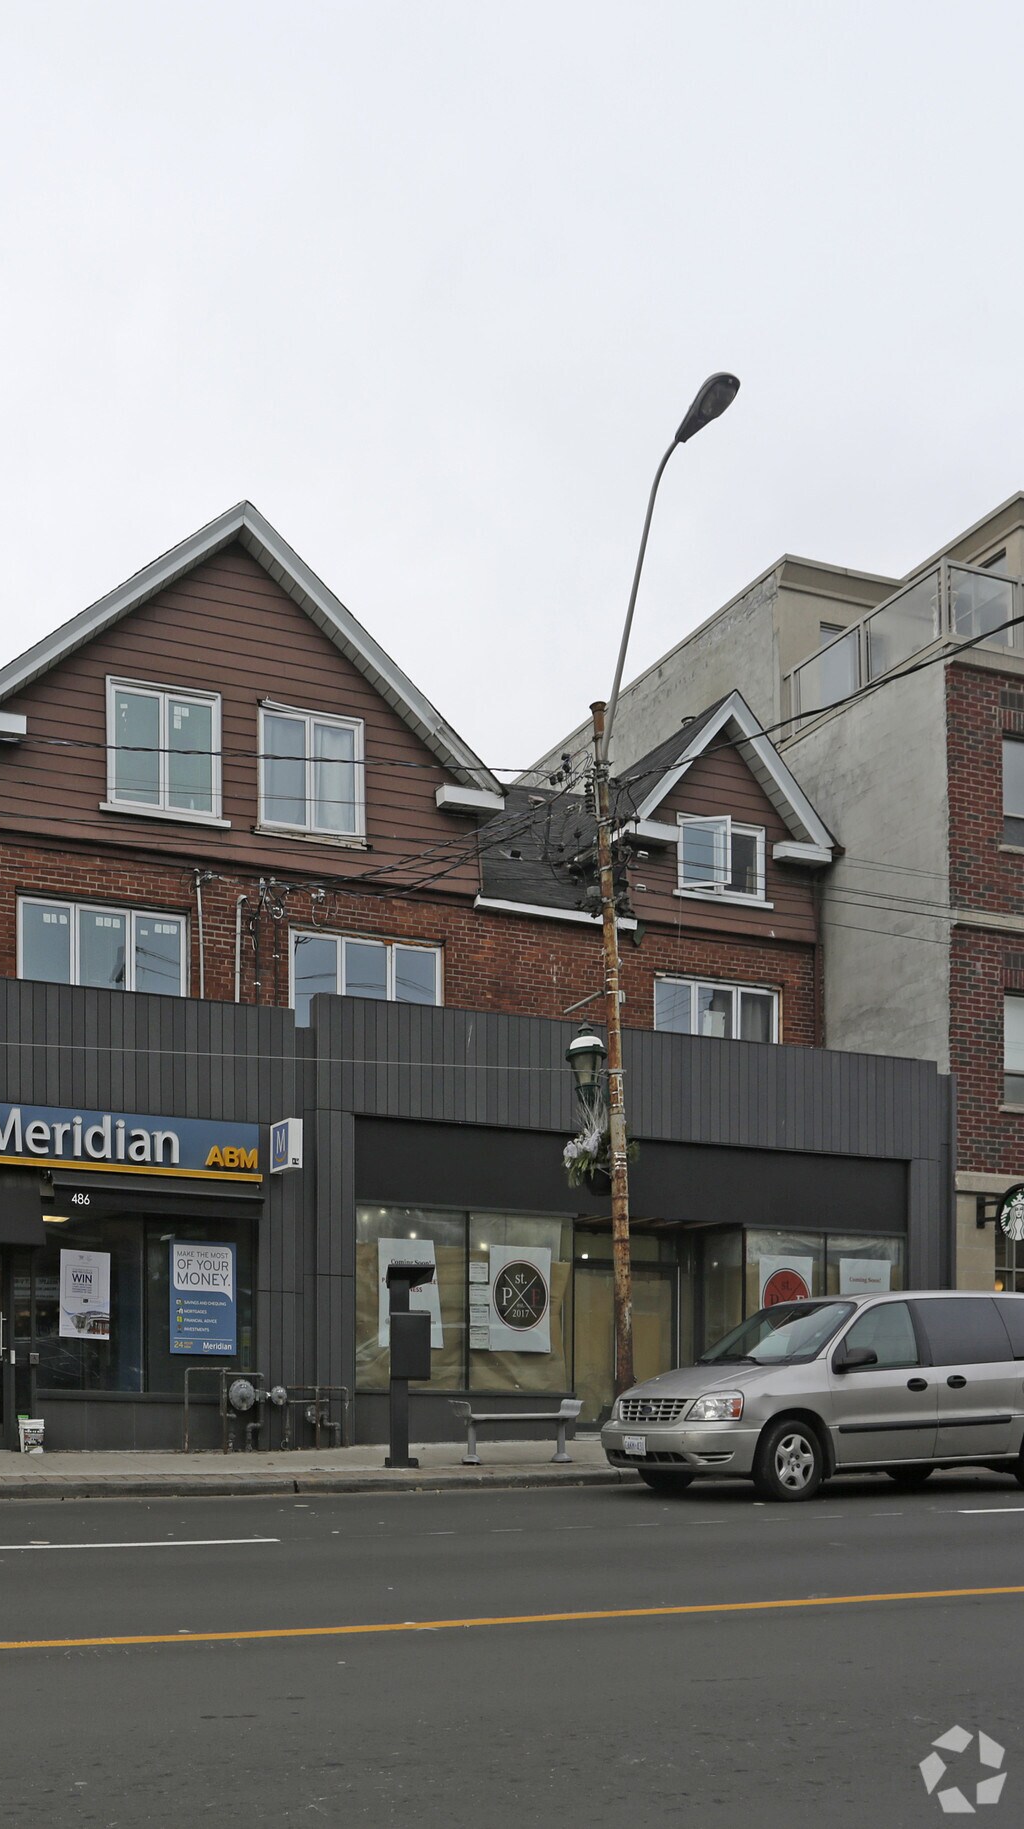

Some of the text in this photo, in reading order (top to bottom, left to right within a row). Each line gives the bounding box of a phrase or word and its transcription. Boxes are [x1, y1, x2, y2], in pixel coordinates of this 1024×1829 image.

[276, 1129, 286, 1154] M
[205, 1144, 259, 1169] ABM
[71, 1193, 91, 1205] 486
[197, 1251, 209, 1259] THE
[177, 1258, 229, 1271] OF YOUR
[71, 1273, 93, 1284] WIN
[177, 1272, 231, 1287] MONEY.
[514, 1273, 528, 1284] st.
[501, 1287, 513, 1306] P
[511, 1309, 530, 1318] 2017
[174, 1341, 184, 1349] 24
[203, 1341, 232, 1350] Meridian
